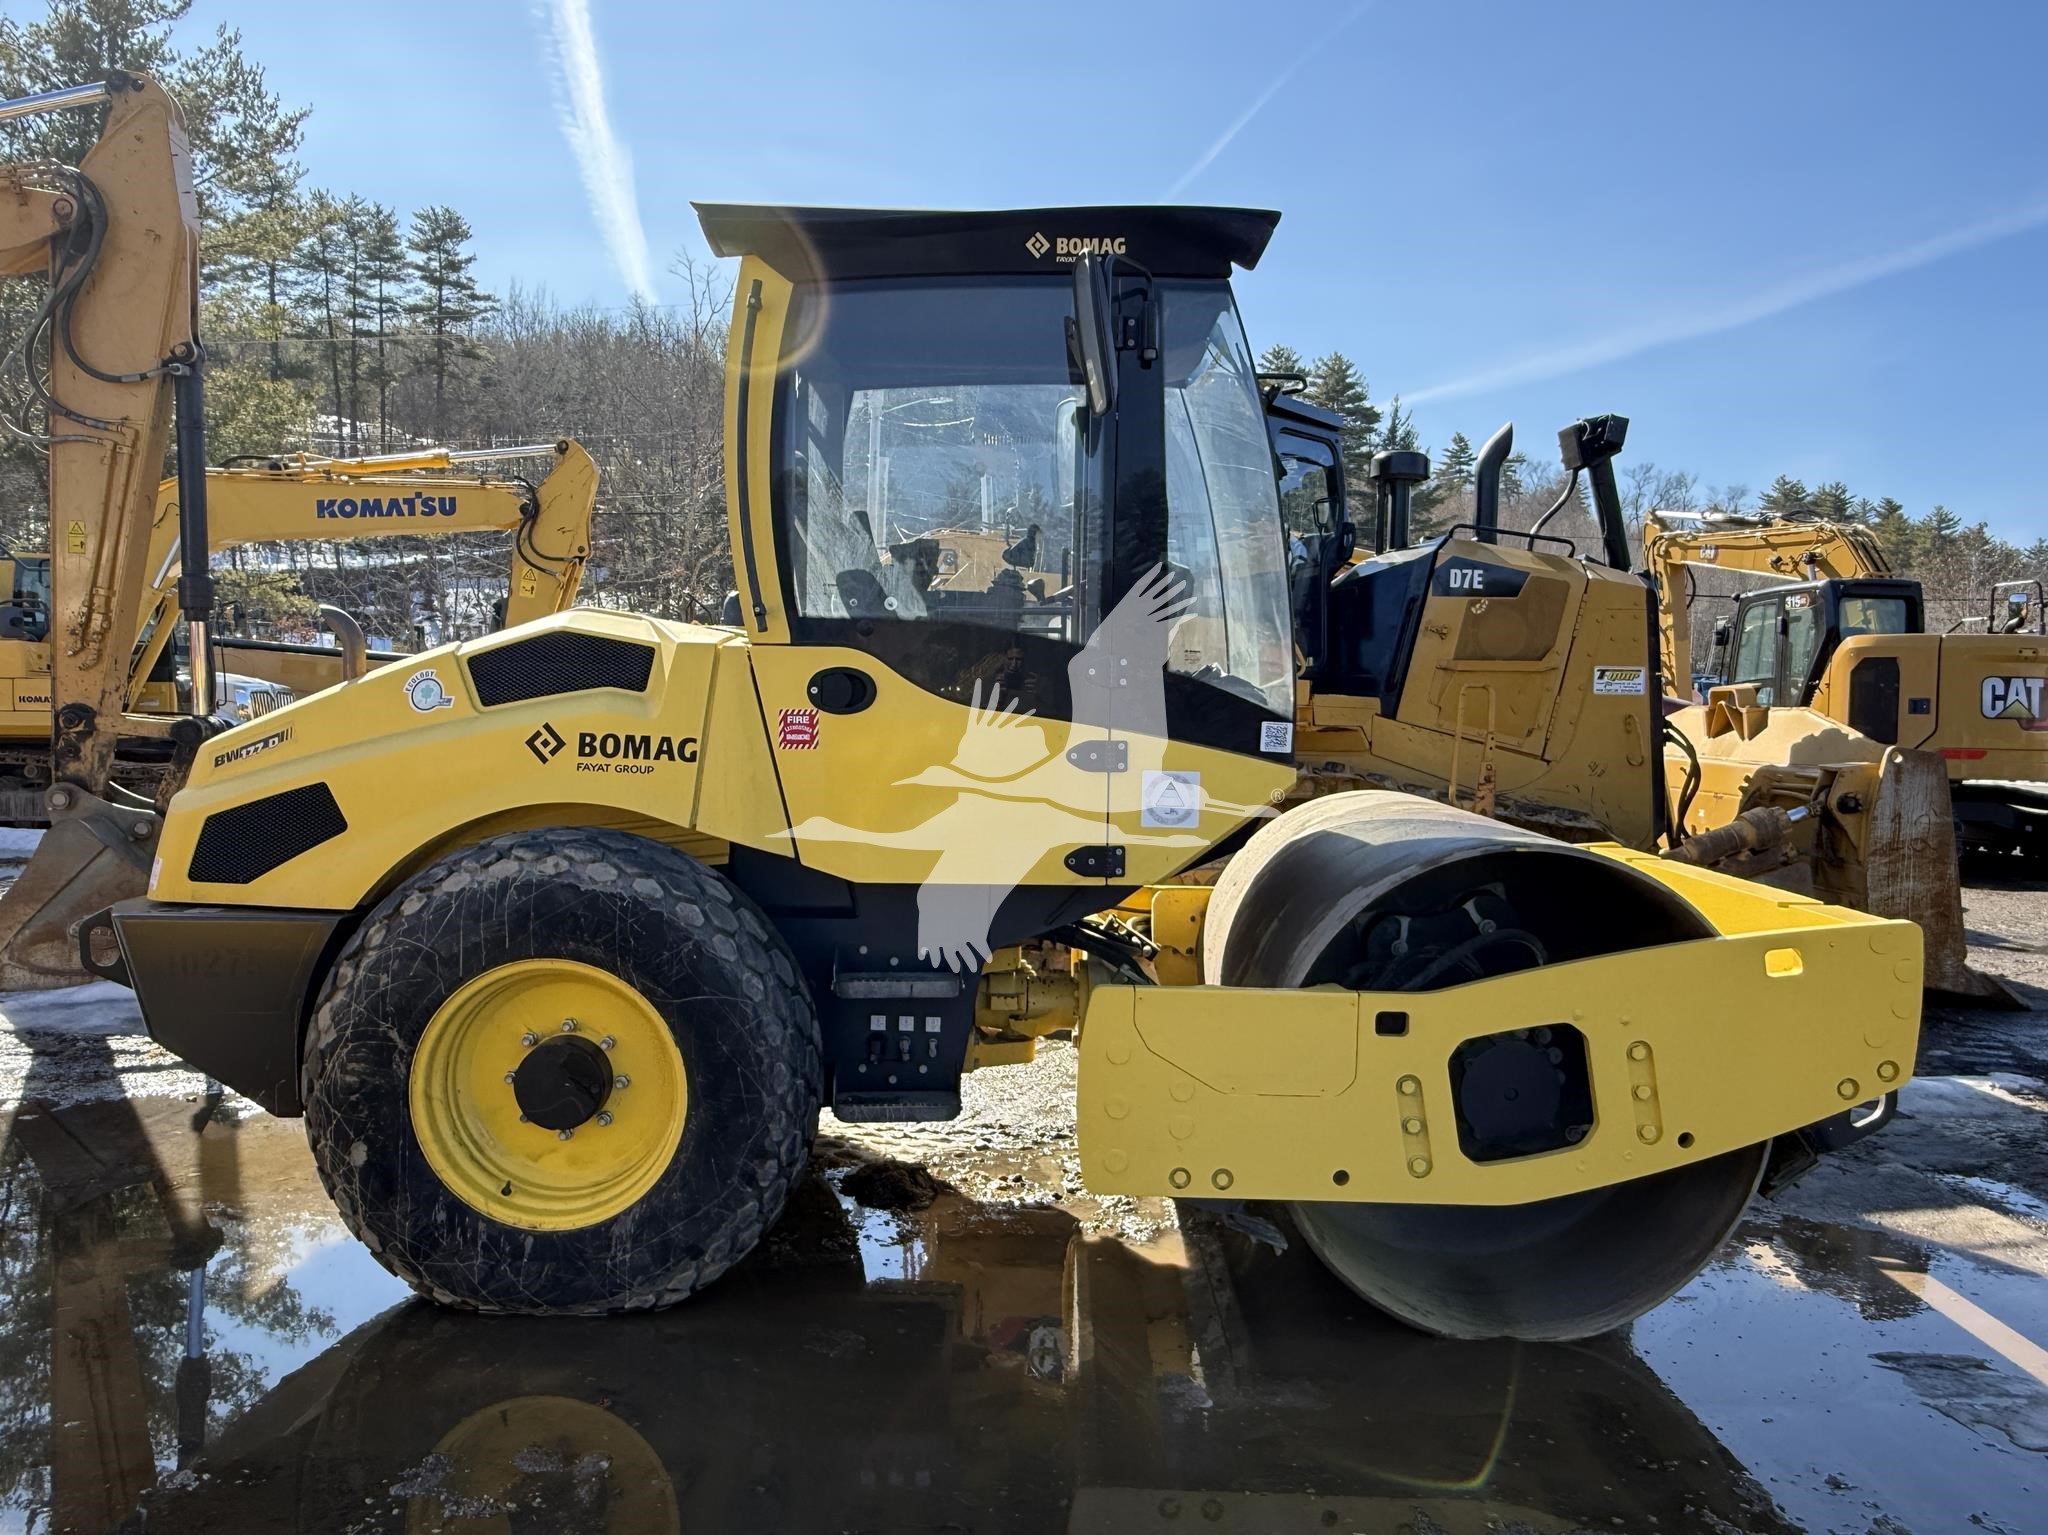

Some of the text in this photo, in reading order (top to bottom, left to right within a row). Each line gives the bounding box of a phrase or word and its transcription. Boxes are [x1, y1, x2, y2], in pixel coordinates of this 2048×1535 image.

[1056, 237, 1126, 255] BOMAG
[316, 491, 457, 519] KOMATSU
[1449, 568, 1484, 590] D7E
[405, 671, 435, 692] ECOLOGY
[18, 695, 53, 704] KOMA
[1982, 677, 2045, 719] CAT
[787, 715, 810, 724] FIRE
[578, 732, 698, 763] BOMAG
[576, 763, 655, 775] FAYAT GROUP
